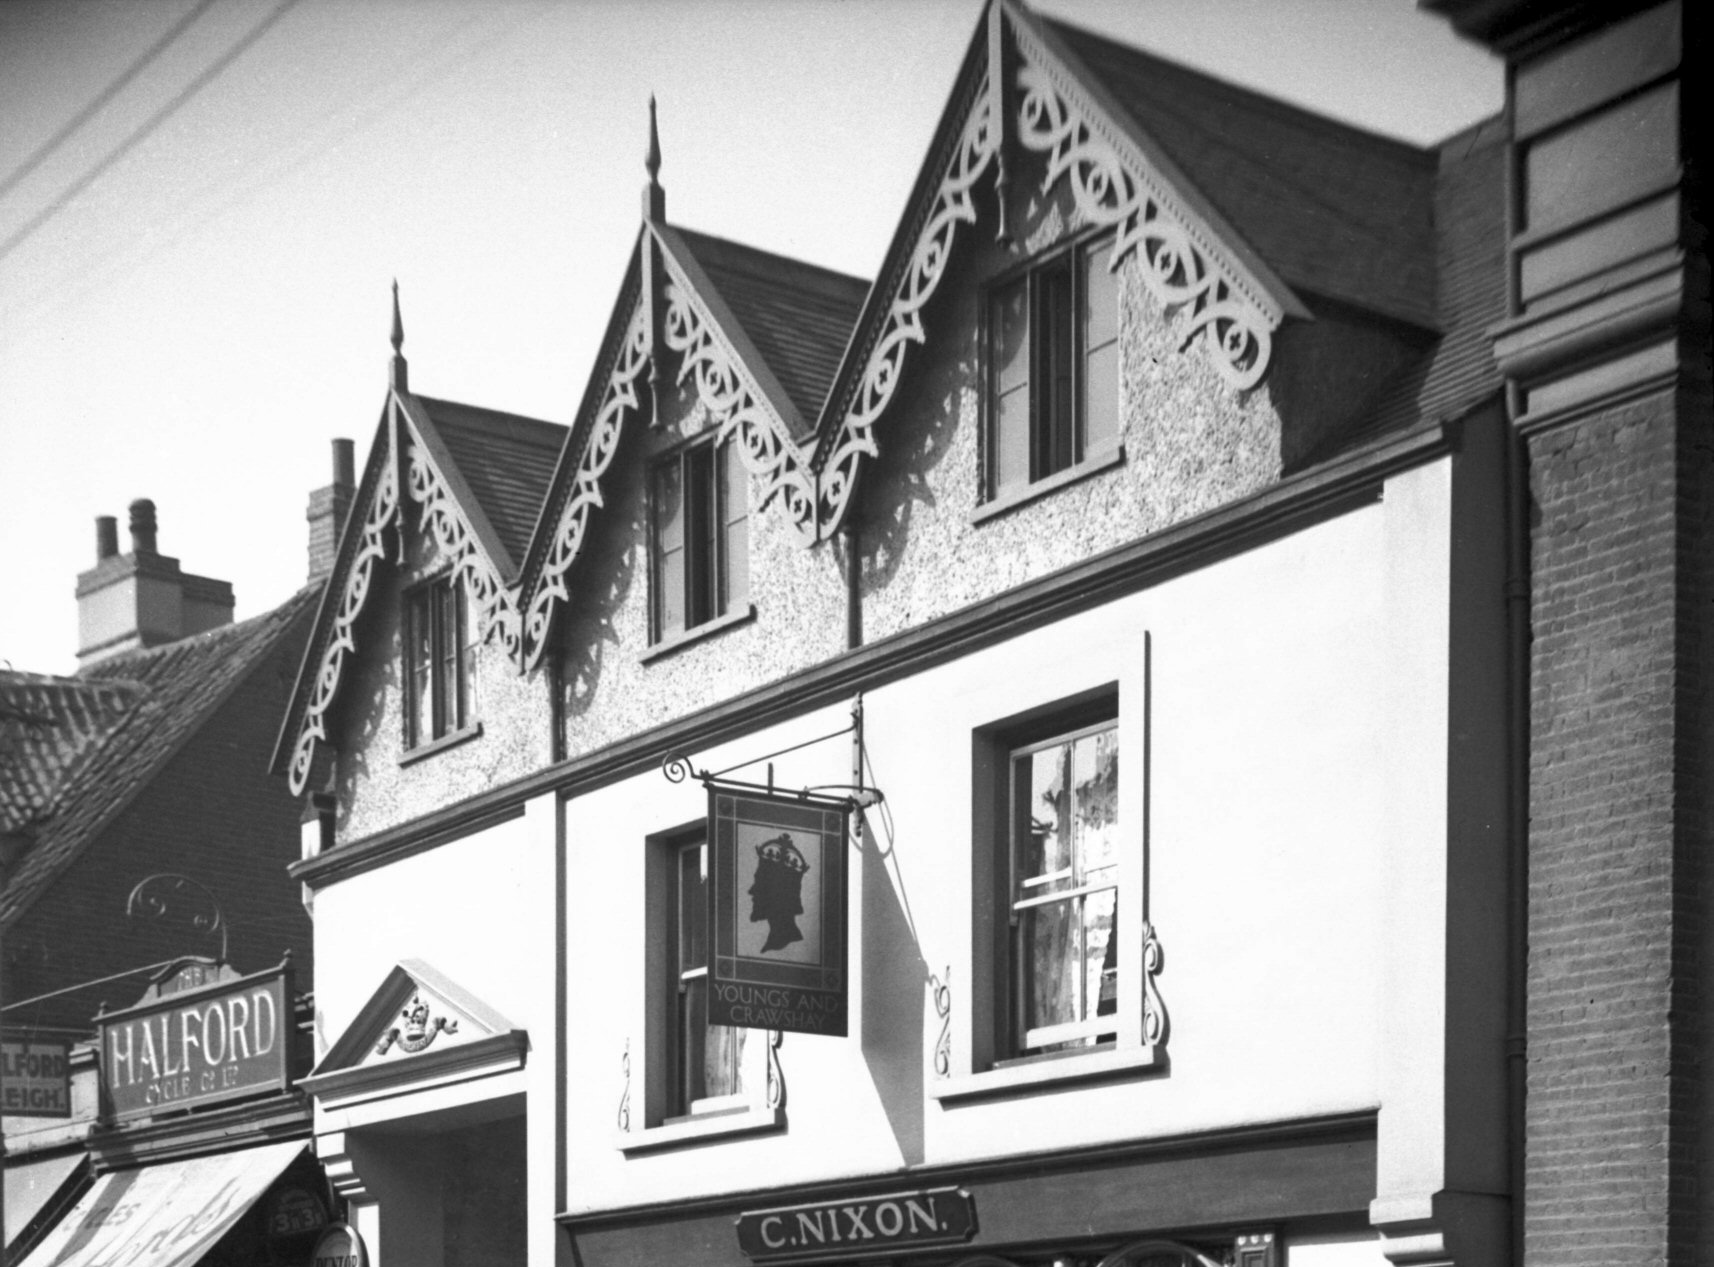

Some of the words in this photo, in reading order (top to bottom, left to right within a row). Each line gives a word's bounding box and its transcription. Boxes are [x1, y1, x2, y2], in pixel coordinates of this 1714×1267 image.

[714, 983, 790, 1008] YOUNGS
[797, 993, 839, 1014] AND
[729, 1004, 826, 1031] CRAWSHAY
[111, 989, 276, 1089] HALFORD
[4, 1087, 65, 1109] EIGH.
[146, 1076, 191, 1104] CYCLE
